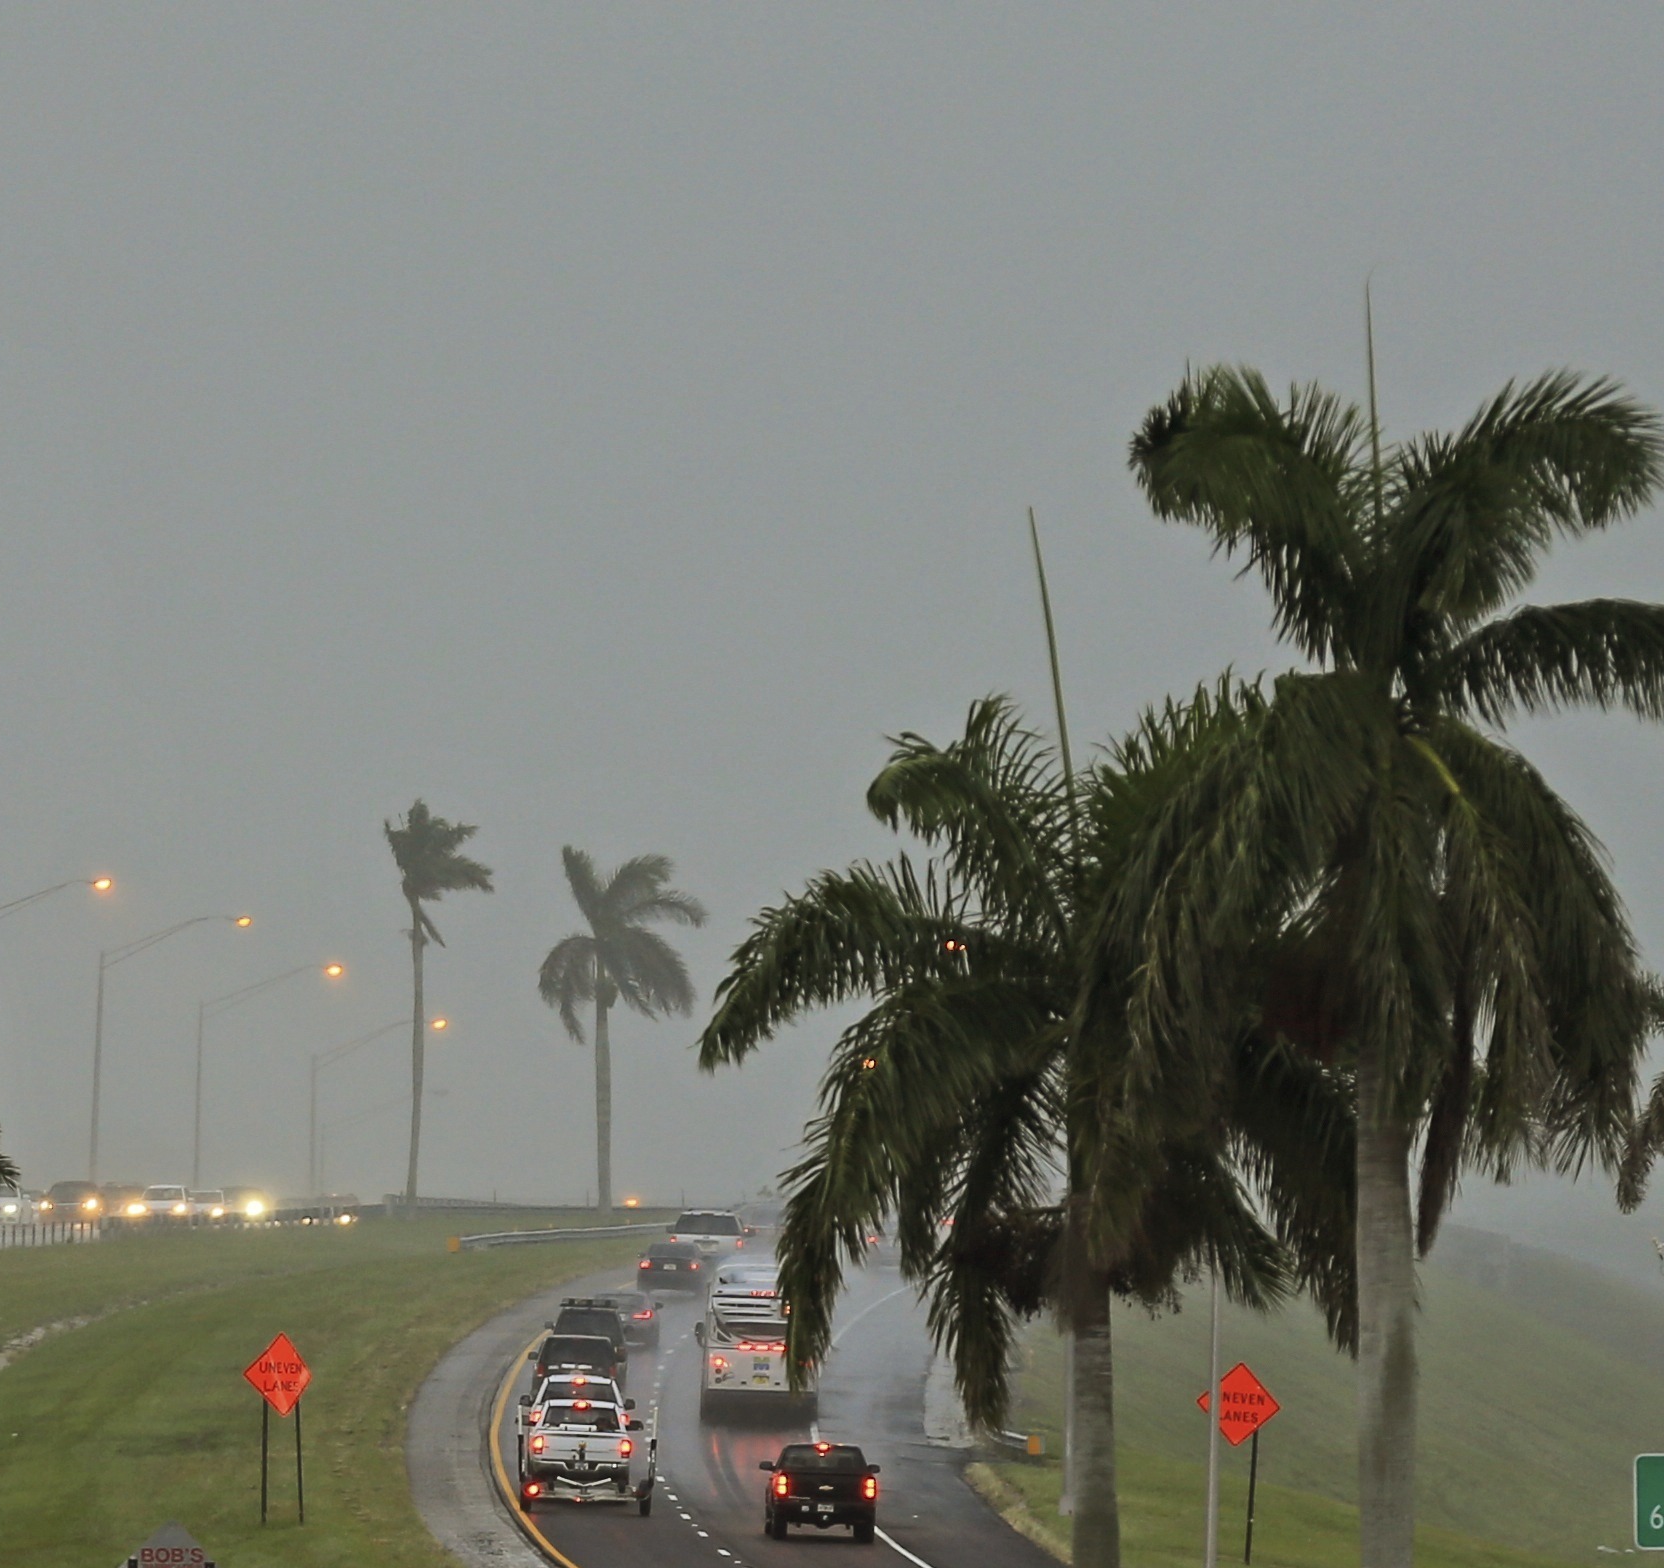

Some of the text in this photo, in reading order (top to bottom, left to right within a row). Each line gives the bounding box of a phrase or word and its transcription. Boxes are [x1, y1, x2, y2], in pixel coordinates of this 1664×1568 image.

[259, 1361, 302, 1374] UNEVEN
[1222, 1392, 1266, 1406] NEVEN
[1220, 1410, 1258, 1424] ANES
[1649, 1504, 1664, 1530] 6
[140, 1547, 204, 1563] BOB'S
